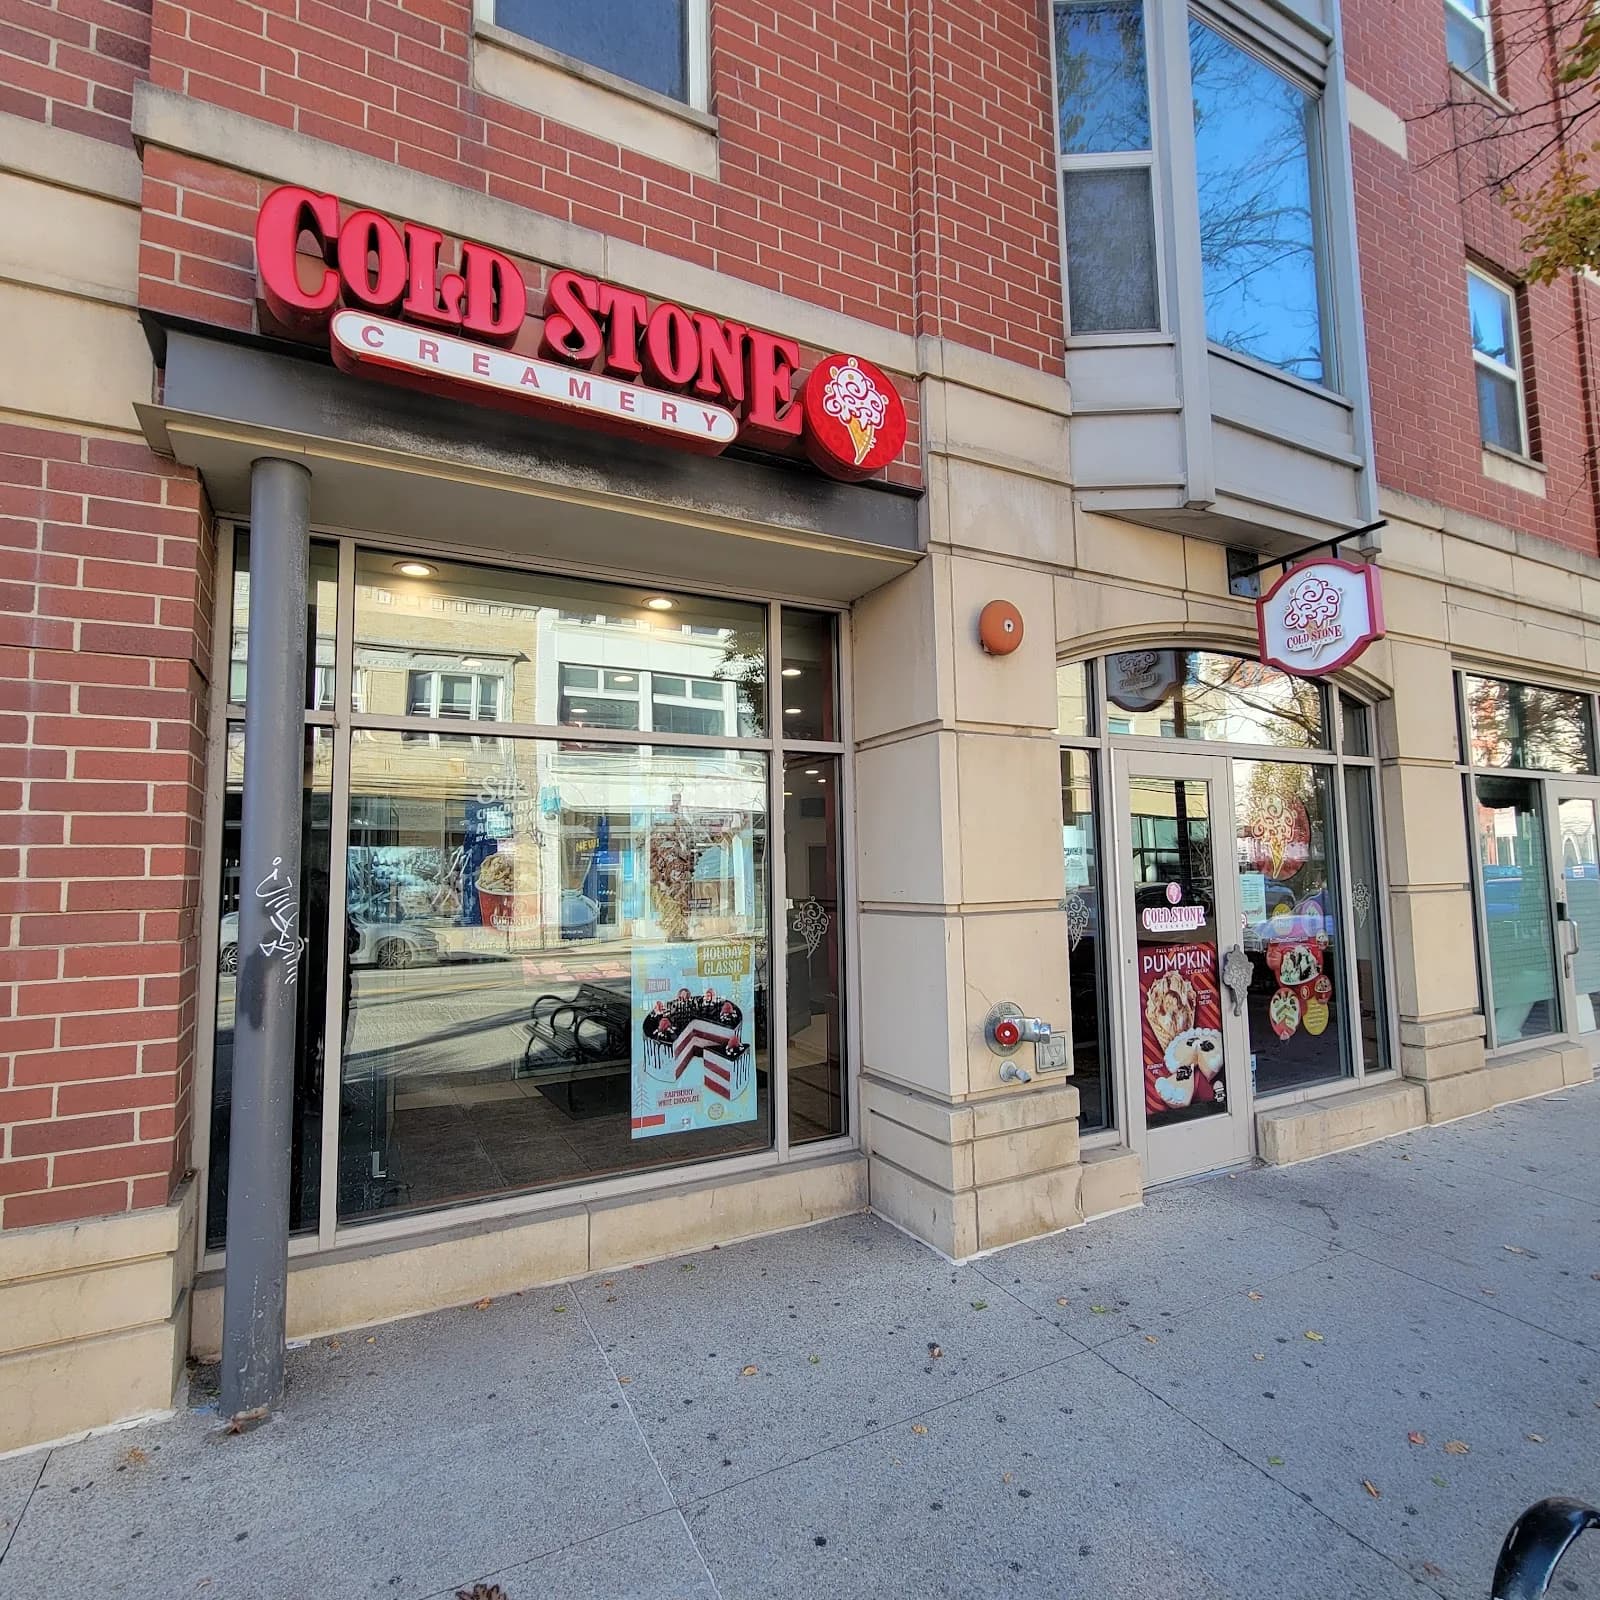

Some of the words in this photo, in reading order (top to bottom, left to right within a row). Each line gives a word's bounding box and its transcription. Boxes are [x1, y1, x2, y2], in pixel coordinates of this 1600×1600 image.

[256, 184, 527, 338] COLD
[542, 269, 804, 436] STONE
[361, 324, 722, 433] CREAMERY
[1287, 633, 1310, 649] COLD
[1311, 625, 1342, 641] STONE
[575, 838, 600, 853] NEW!
[1143, 908, 1171, 928] COLD
[1171, 906, 1205, 925] STONE
[703, 945, 743, 960] HOLIDAY
[1143, 950, 1212, 974] PUMPKIN
[704, 960, 743, 975] CLASSIC
